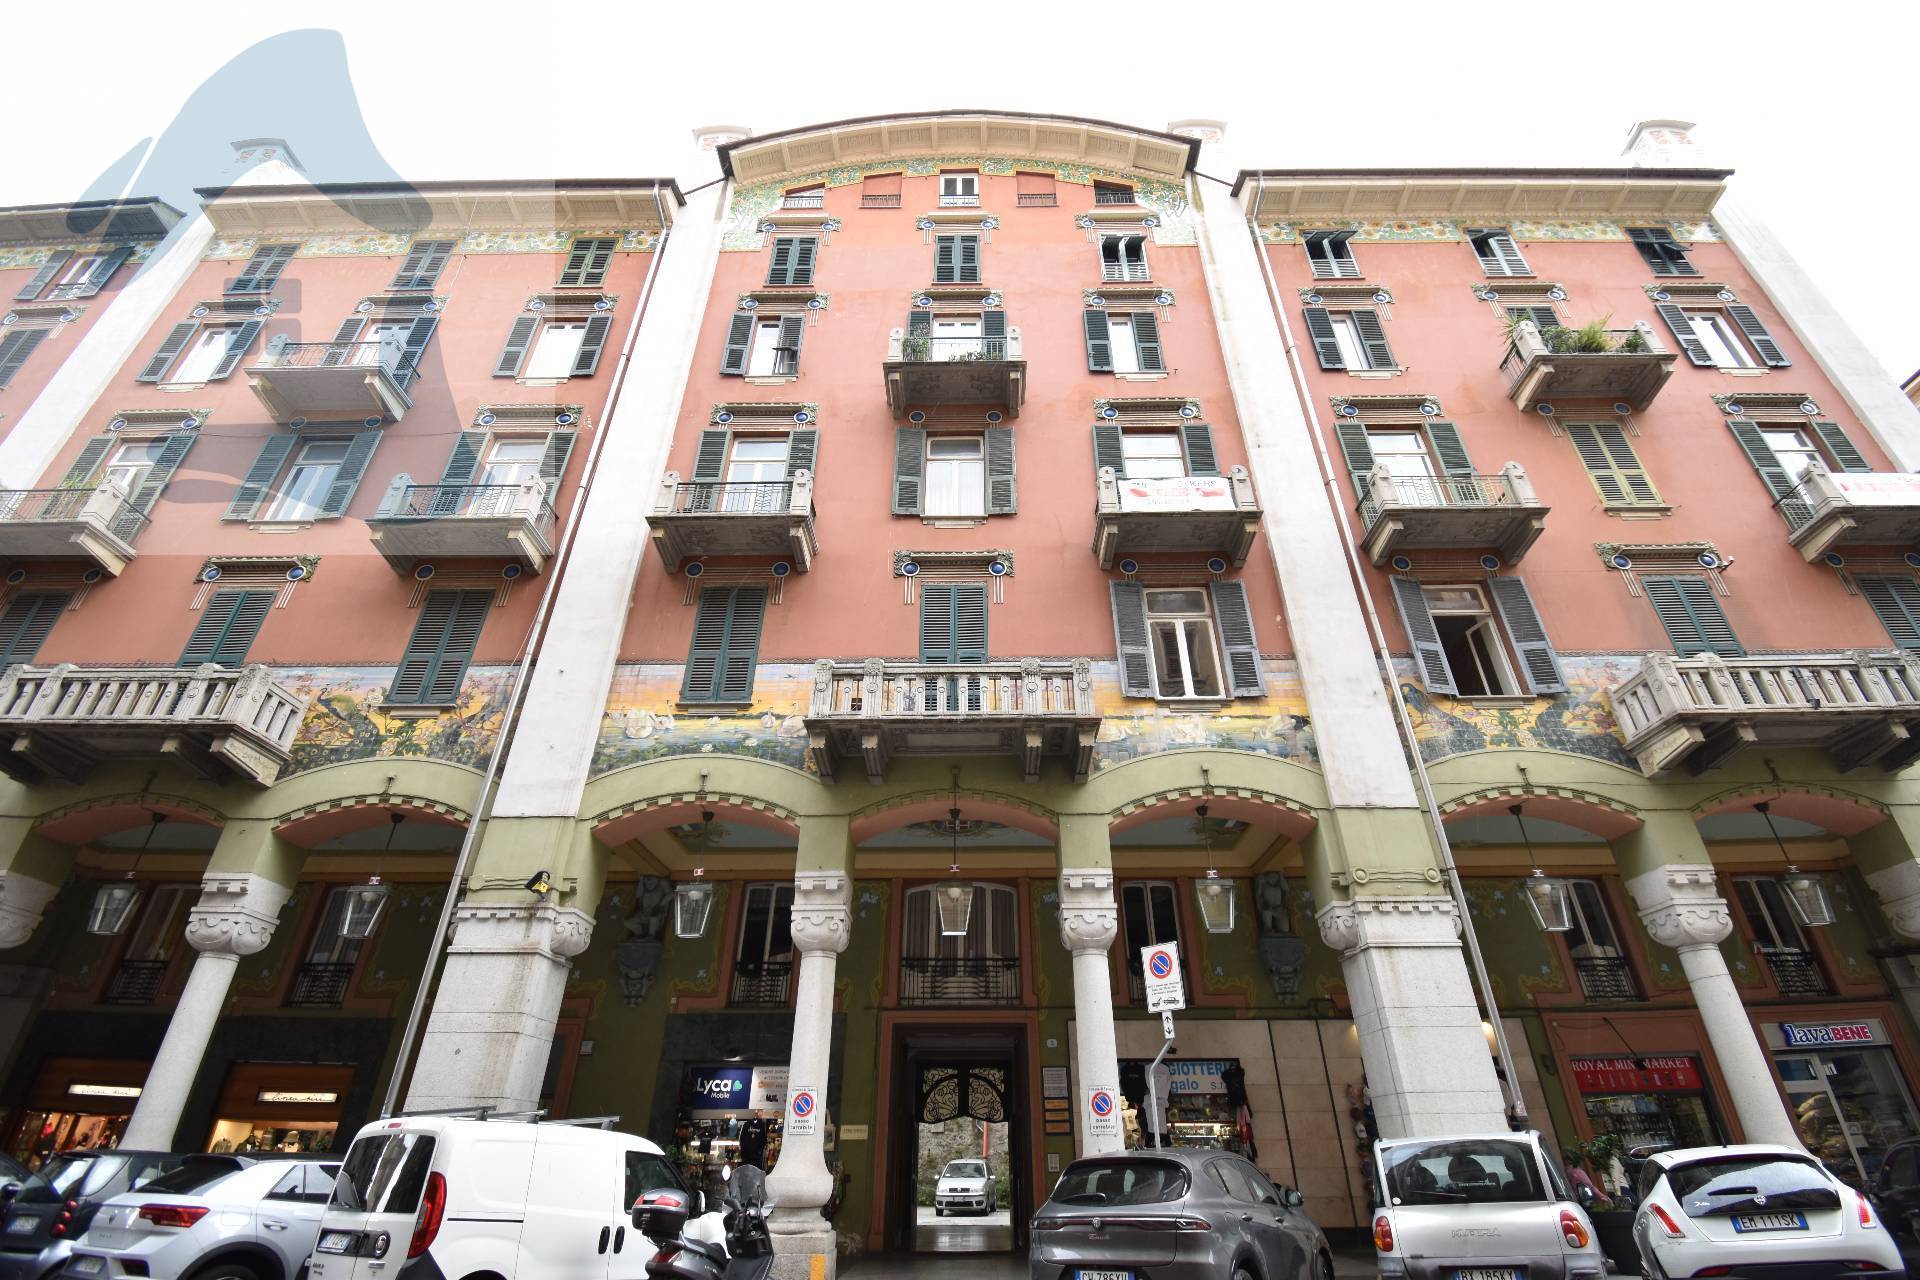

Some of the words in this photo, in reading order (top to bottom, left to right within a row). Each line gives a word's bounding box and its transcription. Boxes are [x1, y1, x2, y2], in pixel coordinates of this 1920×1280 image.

[1786, 1024, 1873, 1044] lavaBENE
[1571, 1058, 1613, 1072] ROYAL
[1614, 1058, 1637, 1070] MIN
[696, 1077, 732, 1095] Lyca
[1170, 1078, 1199, 1092] galo
[710, 1091, 730, 1099] Mobile
[1740, 1215, 1757, 1229] EM
